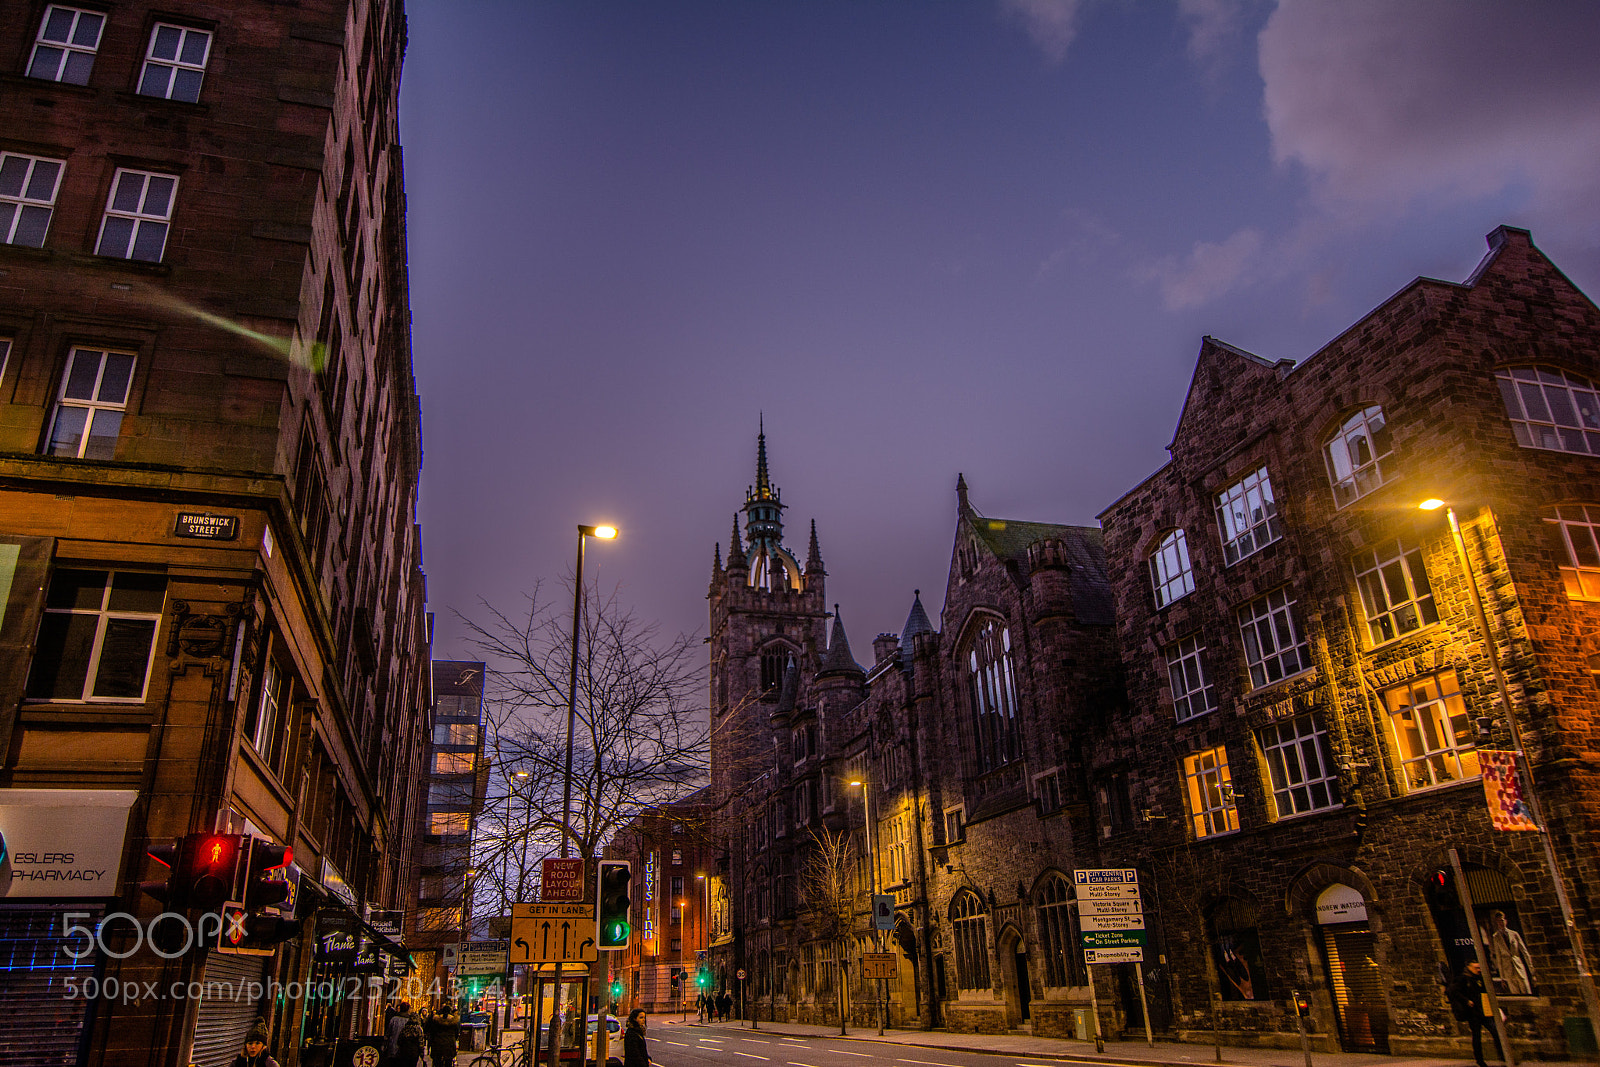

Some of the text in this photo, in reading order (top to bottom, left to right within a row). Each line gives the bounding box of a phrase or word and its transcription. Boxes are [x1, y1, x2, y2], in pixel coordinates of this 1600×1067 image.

[182, 516, 230, 526] BRUNSWICK
[189, 525, 221, 535] STREET
[14, 853, 75, 864] ESLERS
[553, 862, 575, 870] NEW
[10, 870, 106, 881] PHARMACY
[550, 871, 576, 879] ROAD
[645, 852, 654, 902] JURYS
[1077, 872, 1085, 882] P
[1126, 871, 1134, 882] P
[546, 880, 581, 888] LAYOUT
[546, 889, 578, 897] AHEAD
[529, 906, 584, 914] GET IN LANE
[1340, 901, 1365, 910] WATSON
